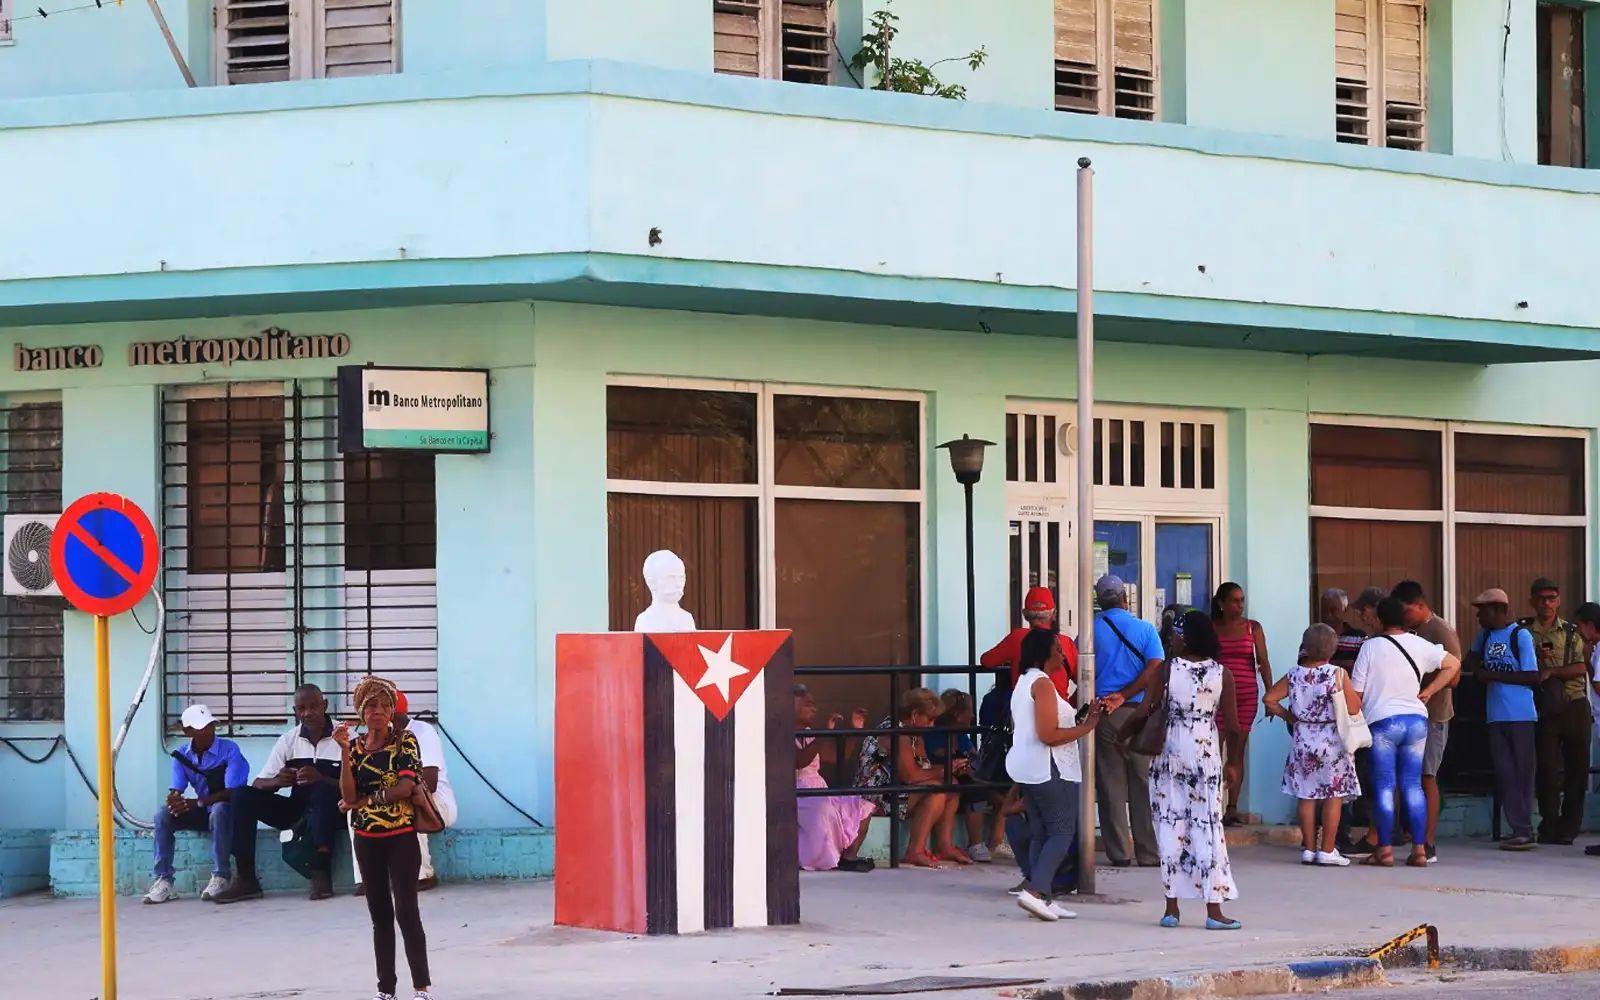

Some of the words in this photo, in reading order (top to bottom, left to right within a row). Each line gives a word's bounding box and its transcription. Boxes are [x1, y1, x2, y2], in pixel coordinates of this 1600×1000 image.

[13, 342, 104, 371] banco
[128, 326, 351, 367] metropolitano
[393, 394, 419, 408] Banco
[421, 394, 482, 411] Metropolitano
[429, 435, 446, 445] Banco
[463, 435, 483, 446] Capital
